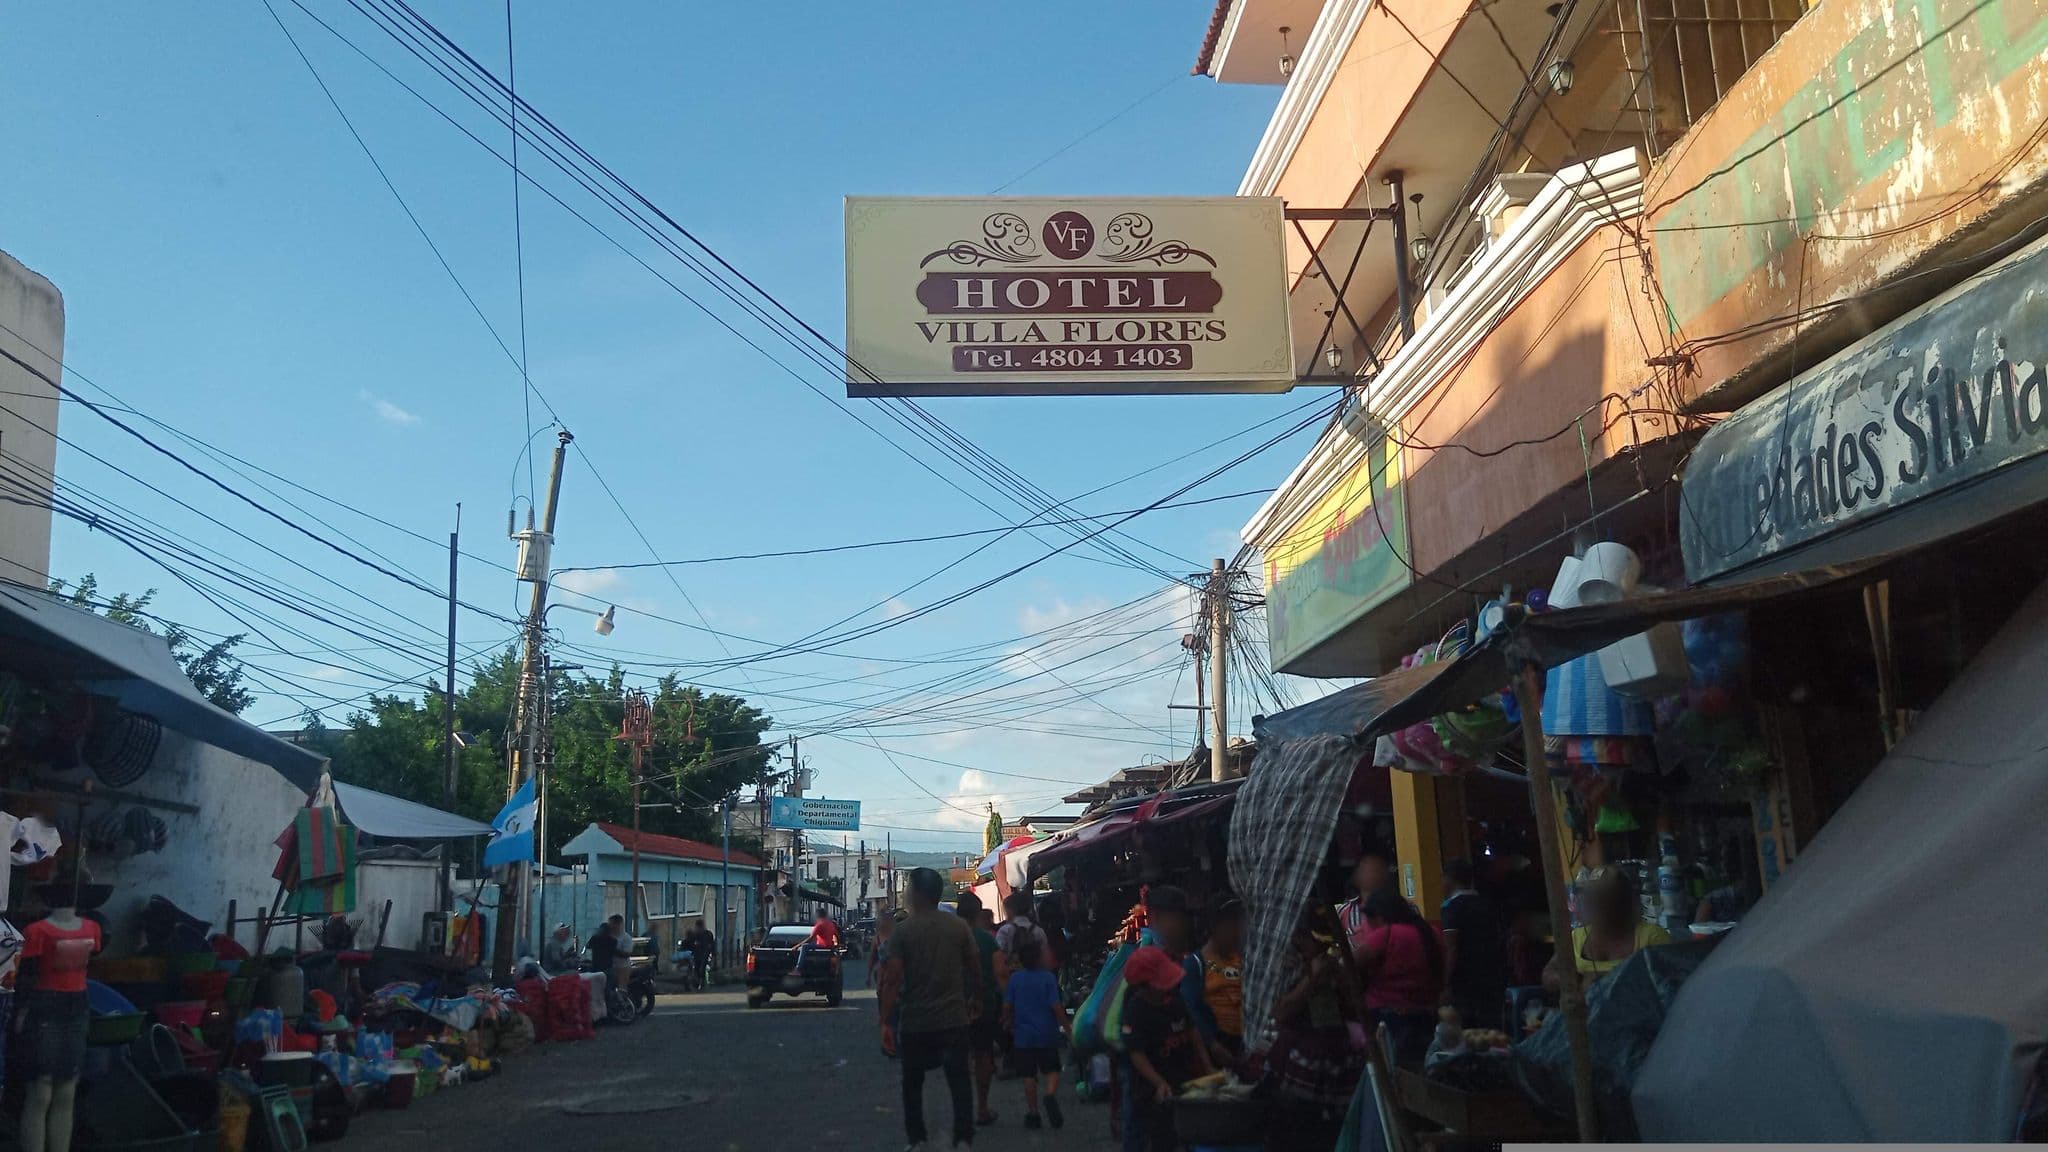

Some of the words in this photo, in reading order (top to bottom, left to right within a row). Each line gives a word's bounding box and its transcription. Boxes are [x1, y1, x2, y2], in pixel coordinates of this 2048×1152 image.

[1050, 220, 1087, 251] VF
[952, 277, 1188, 310] HOTEL
[915, 320, 1050, 344] VILLA
[1060, 319, 1227, 344] FLORES
[964, 349, 1021, 368] Tel.
[1032, 348, 1103, 367] 4804
[1113, 348, 1182, 367] 1403
[1892, 336, 2048, 484] Silvia
[798, 810, 857, 819] Departamental
[804, 818, 850, 827] Chiquimula
